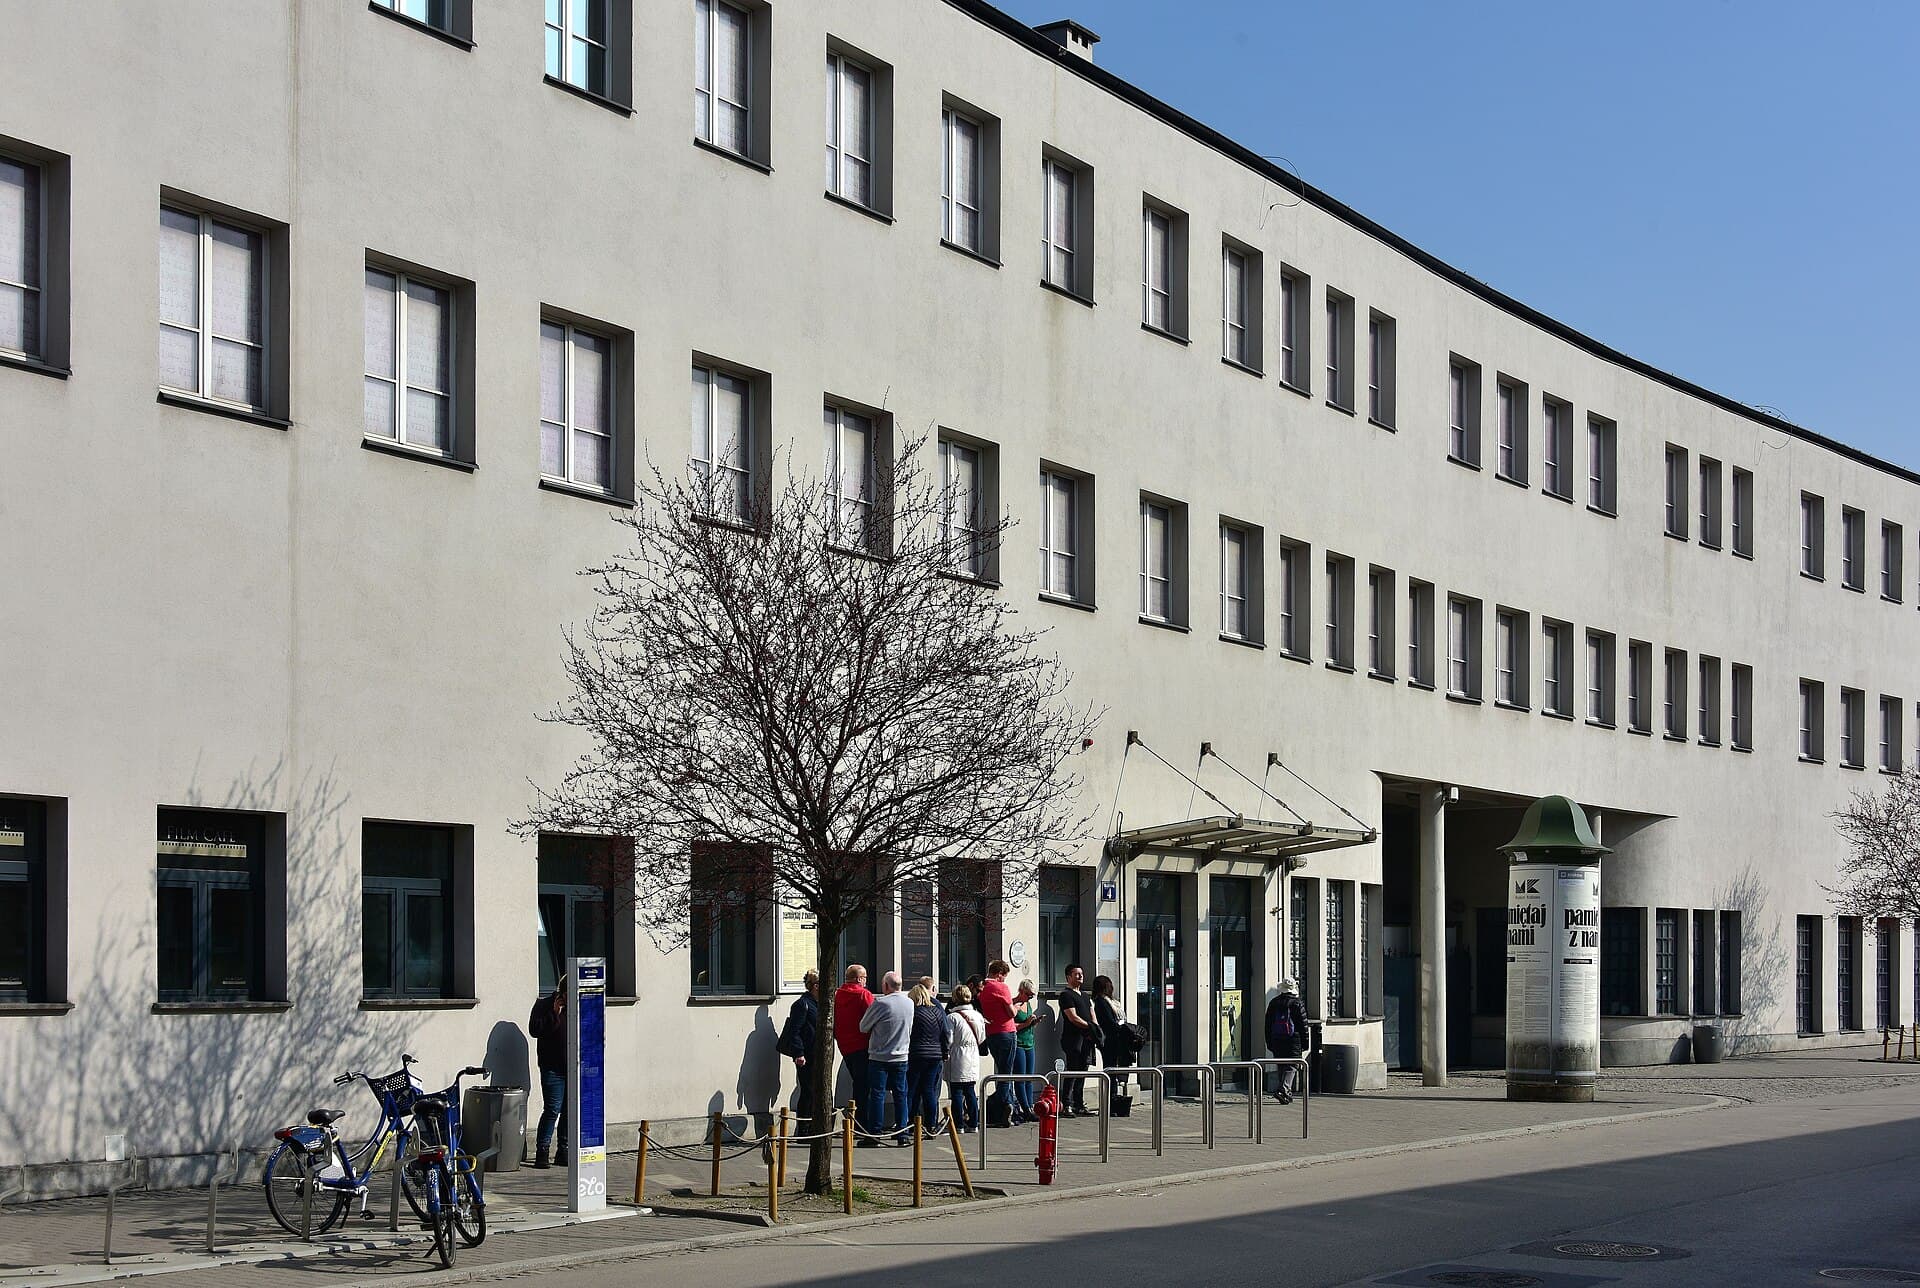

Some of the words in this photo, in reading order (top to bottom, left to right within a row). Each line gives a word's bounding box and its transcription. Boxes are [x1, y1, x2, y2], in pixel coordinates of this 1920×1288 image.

[1106, 887, 1112, 899] 4
[1515, 878, 1540, 894] MK
[1569, 931, 1577, 947] z
